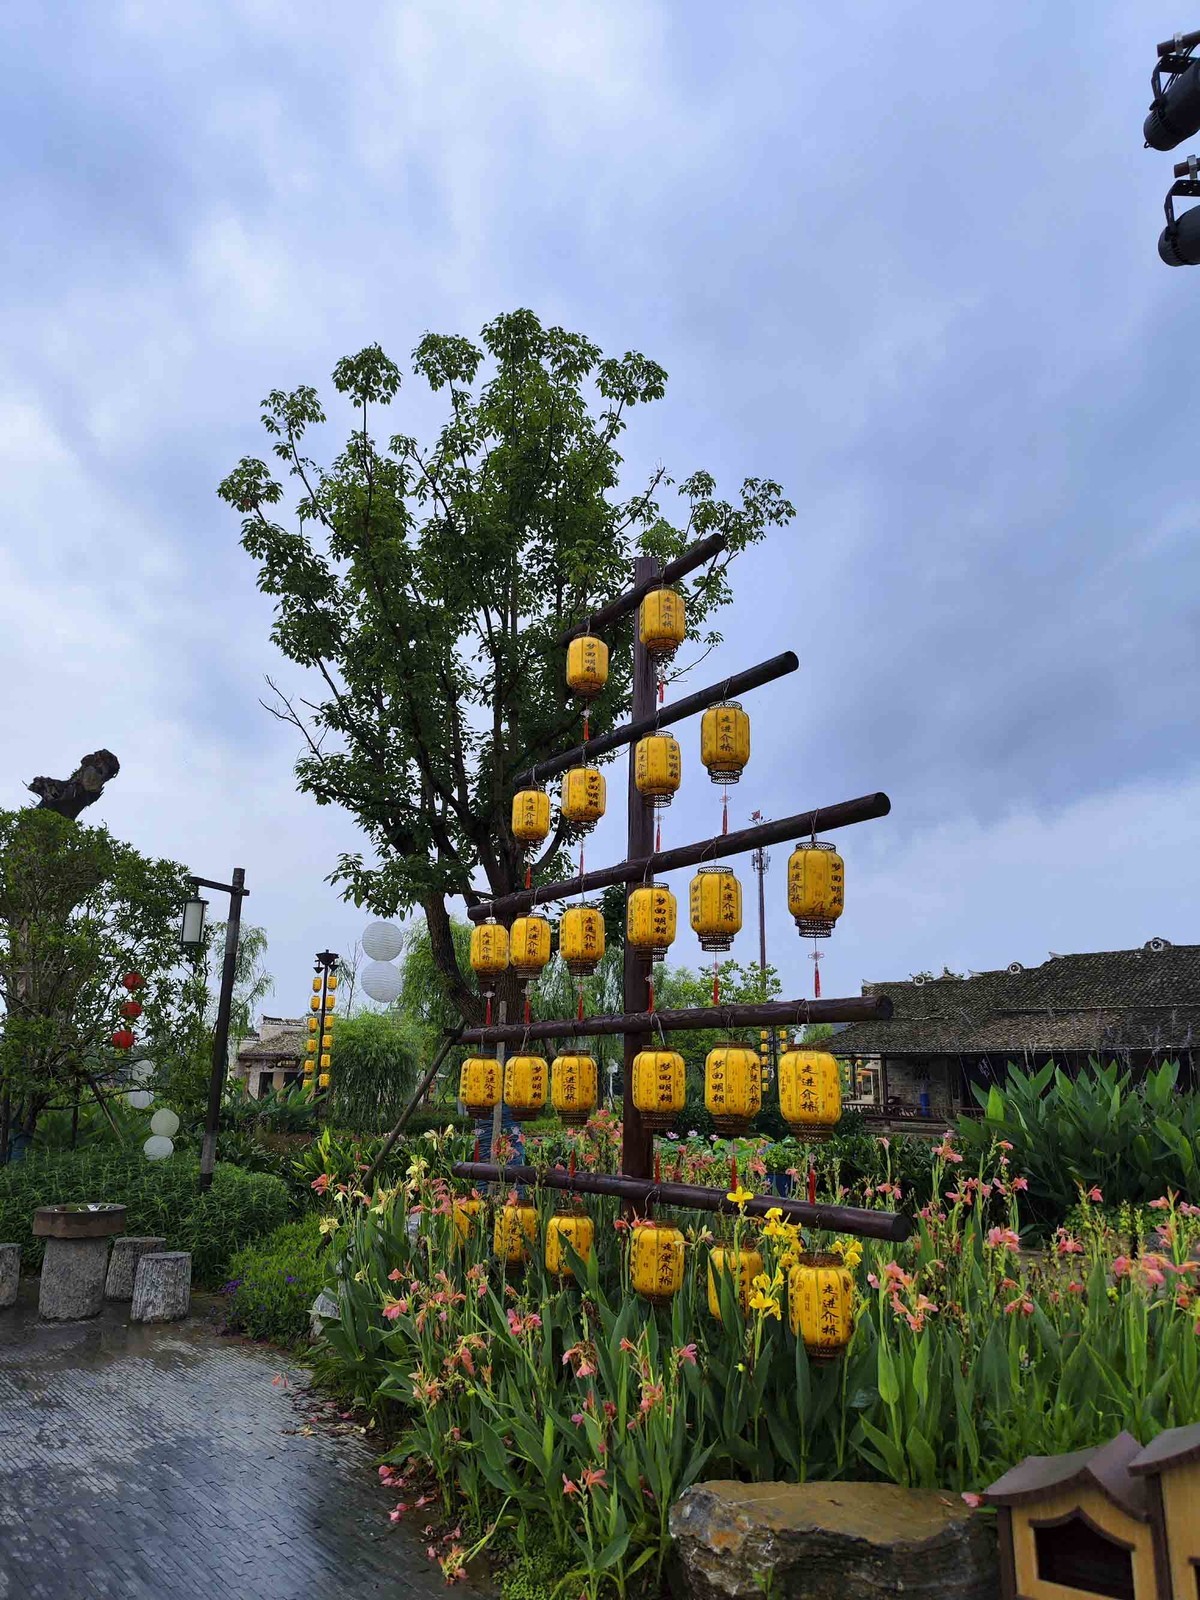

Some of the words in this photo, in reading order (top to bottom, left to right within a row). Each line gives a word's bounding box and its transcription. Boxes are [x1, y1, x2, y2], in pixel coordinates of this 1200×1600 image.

[719, 715, 734, 752] 走进介桥
[722, 883, 735, 921] 走进介桥
[527, 926, 539, 956] 走进介桥
[584, 917, 596, 950] 走进介桥
[659, 1063, 671, 1102] 梦回明朝
[712, 1060, 725, 1103] 梦回明朝
[801, 1064, 818, 1112] 走进介桥
[821, 1284, 839, 1336] 走进介桥
